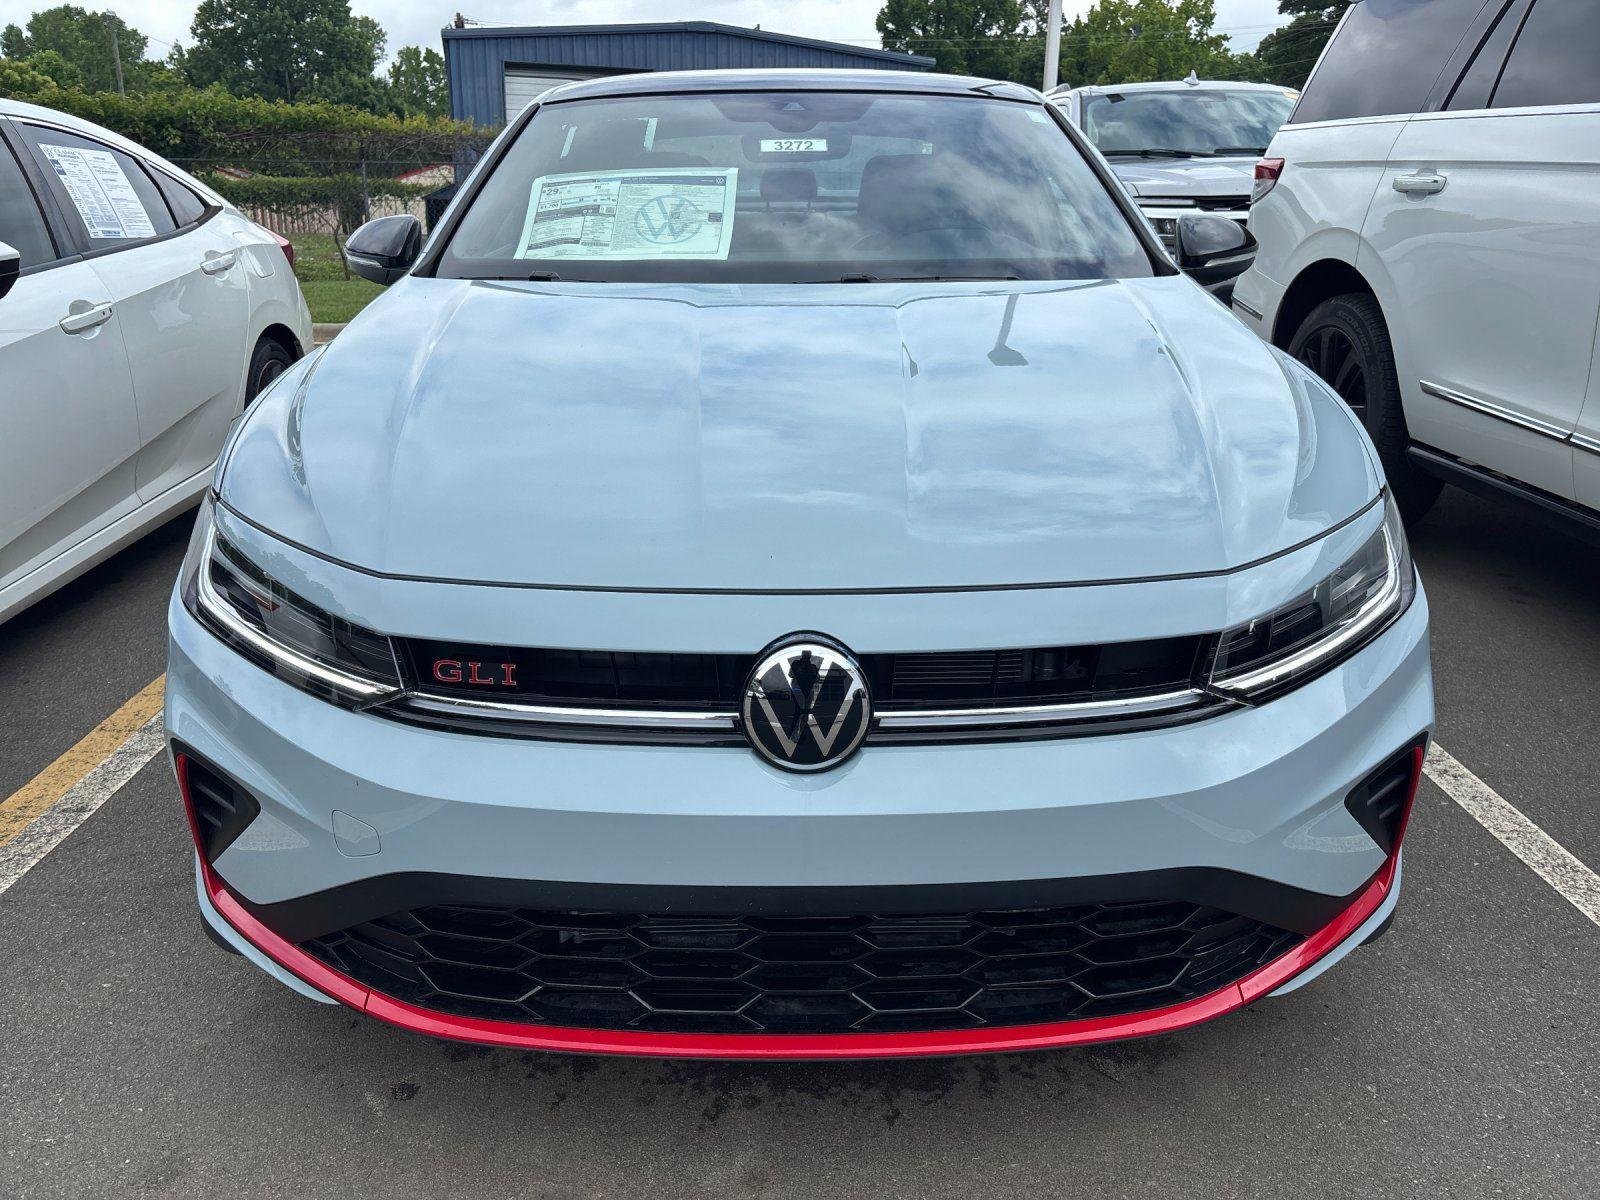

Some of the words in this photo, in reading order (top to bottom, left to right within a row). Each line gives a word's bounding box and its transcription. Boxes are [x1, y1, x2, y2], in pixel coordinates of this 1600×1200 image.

[774, 140, 814, 151] 3272
[1335, 309, 1373, 357] SCORPION
[432, 659, 517, 686] GLI
